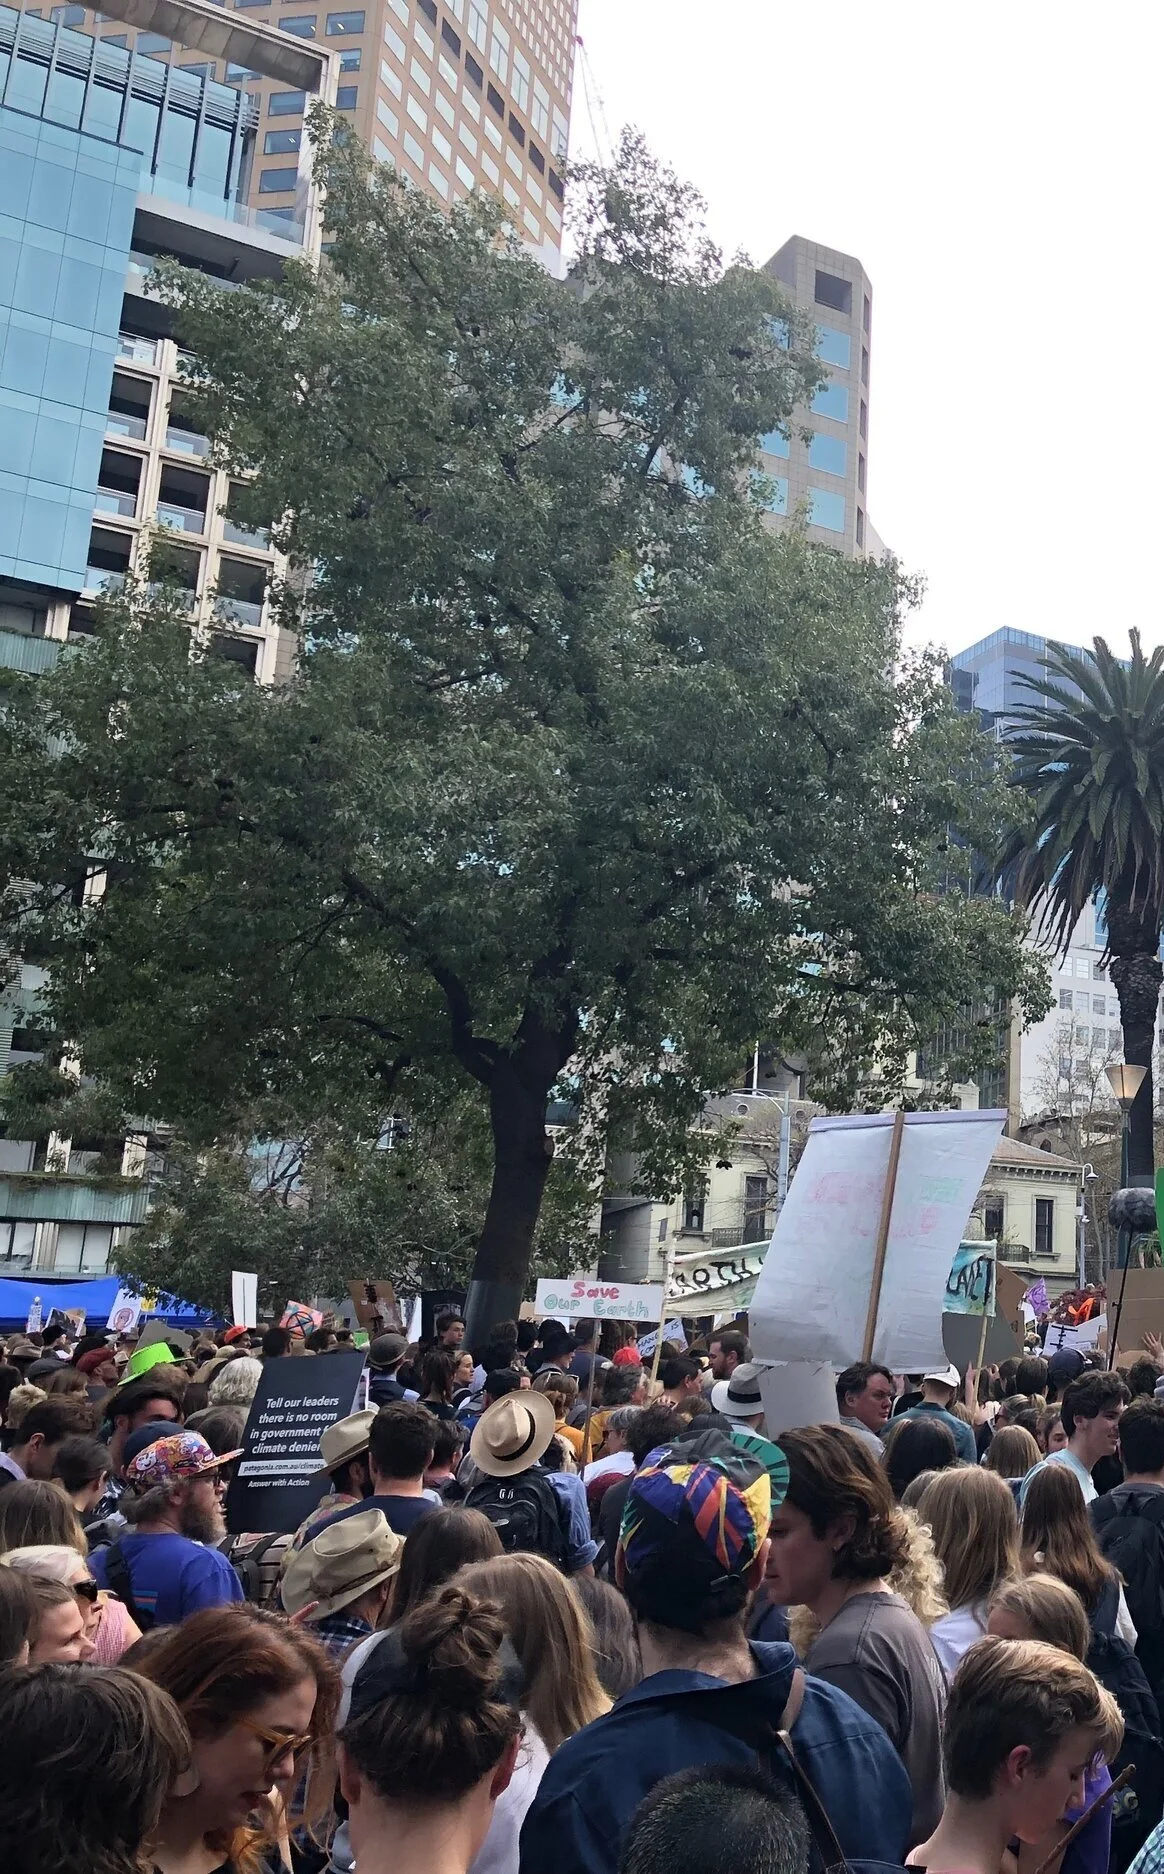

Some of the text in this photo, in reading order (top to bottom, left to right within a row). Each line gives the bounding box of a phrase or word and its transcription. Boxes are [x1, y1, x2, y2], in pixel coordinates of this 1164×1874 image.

[571, 1281, 620, 1300] Save
[544, 1294, 649, 1318] Our Earth
[266, 1395, 339, 1409] Tell our leaders
[258, 1412, 337, 1424] there is no room
[250, 1428, 259, 1439] in
[261, 1426, 321, 1441] government
[252, 1443, 287, 1454] climate
[248, 1478, 310, 1488] Answer with Action
